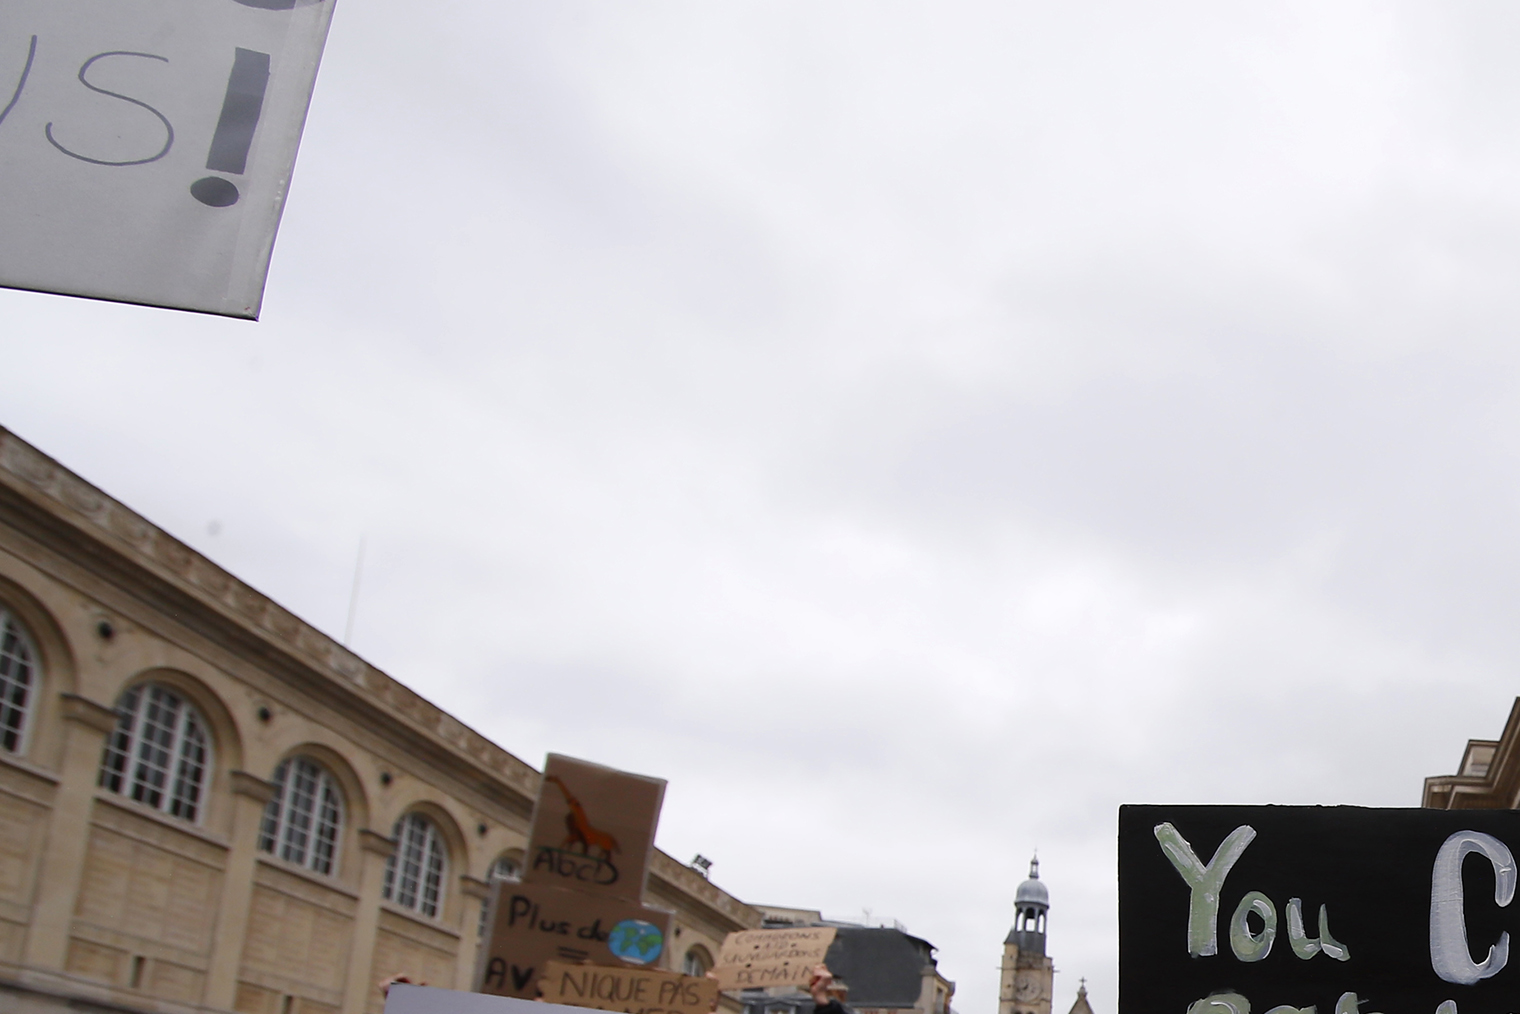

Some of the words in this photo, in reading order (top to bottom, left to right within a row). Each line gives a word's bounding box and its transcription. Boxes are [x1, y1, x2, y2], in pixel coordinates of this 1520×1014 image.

[1152, 821, 1351, 963] You
[508, 894, 571, 936] Plus
[559, 970, 648, 1004] NIQUE
[658, 979, 700, 1007] PAS
